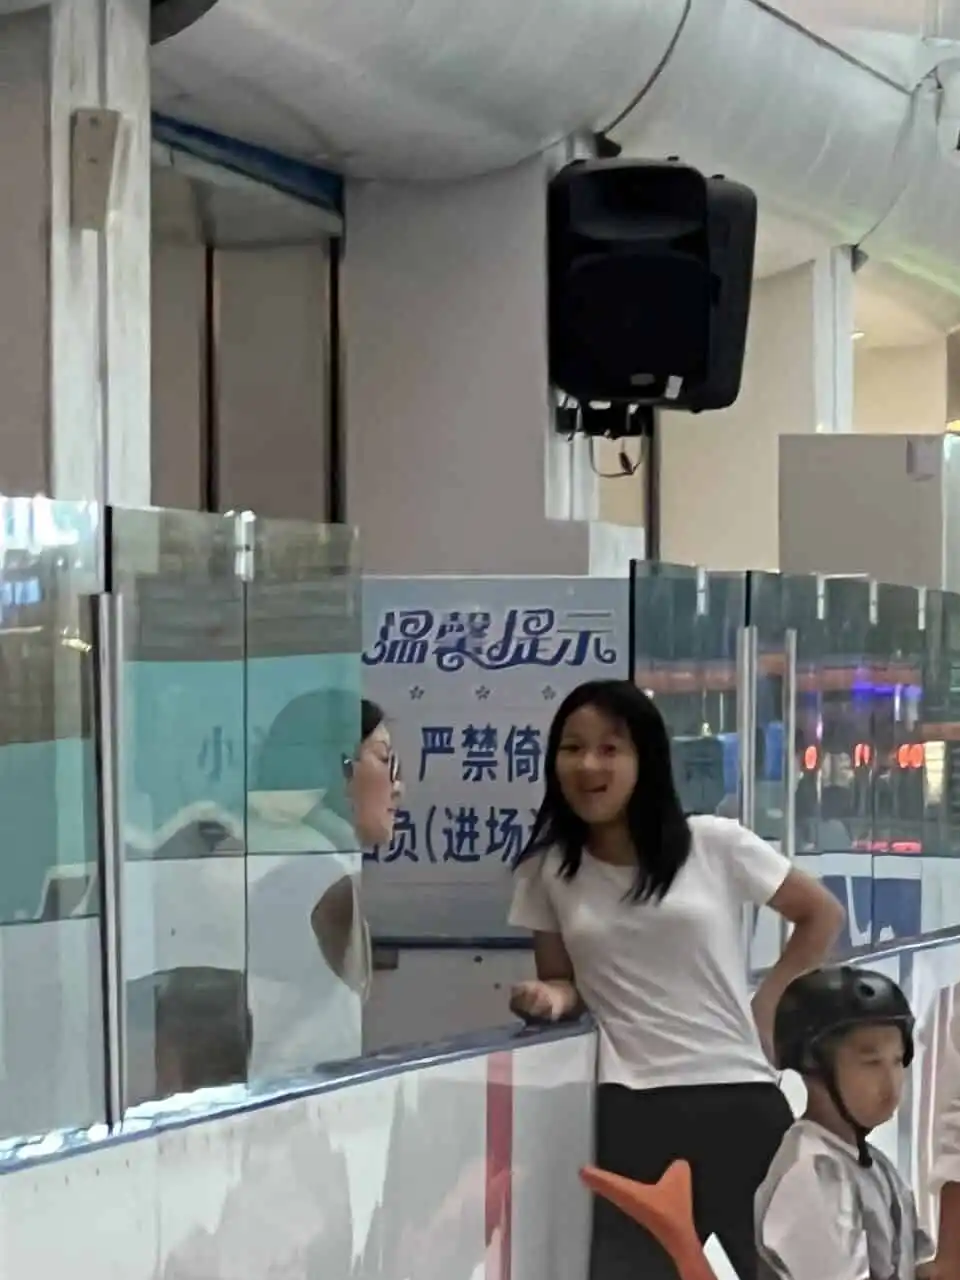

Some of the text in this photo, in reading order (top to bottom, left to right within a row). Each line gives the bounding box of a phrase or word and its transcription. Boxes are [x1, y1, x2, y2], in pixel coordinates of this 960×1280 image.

[361, 608, 617, 671] 温馨提示
[418, 722, 542, 784] 严禁倚
